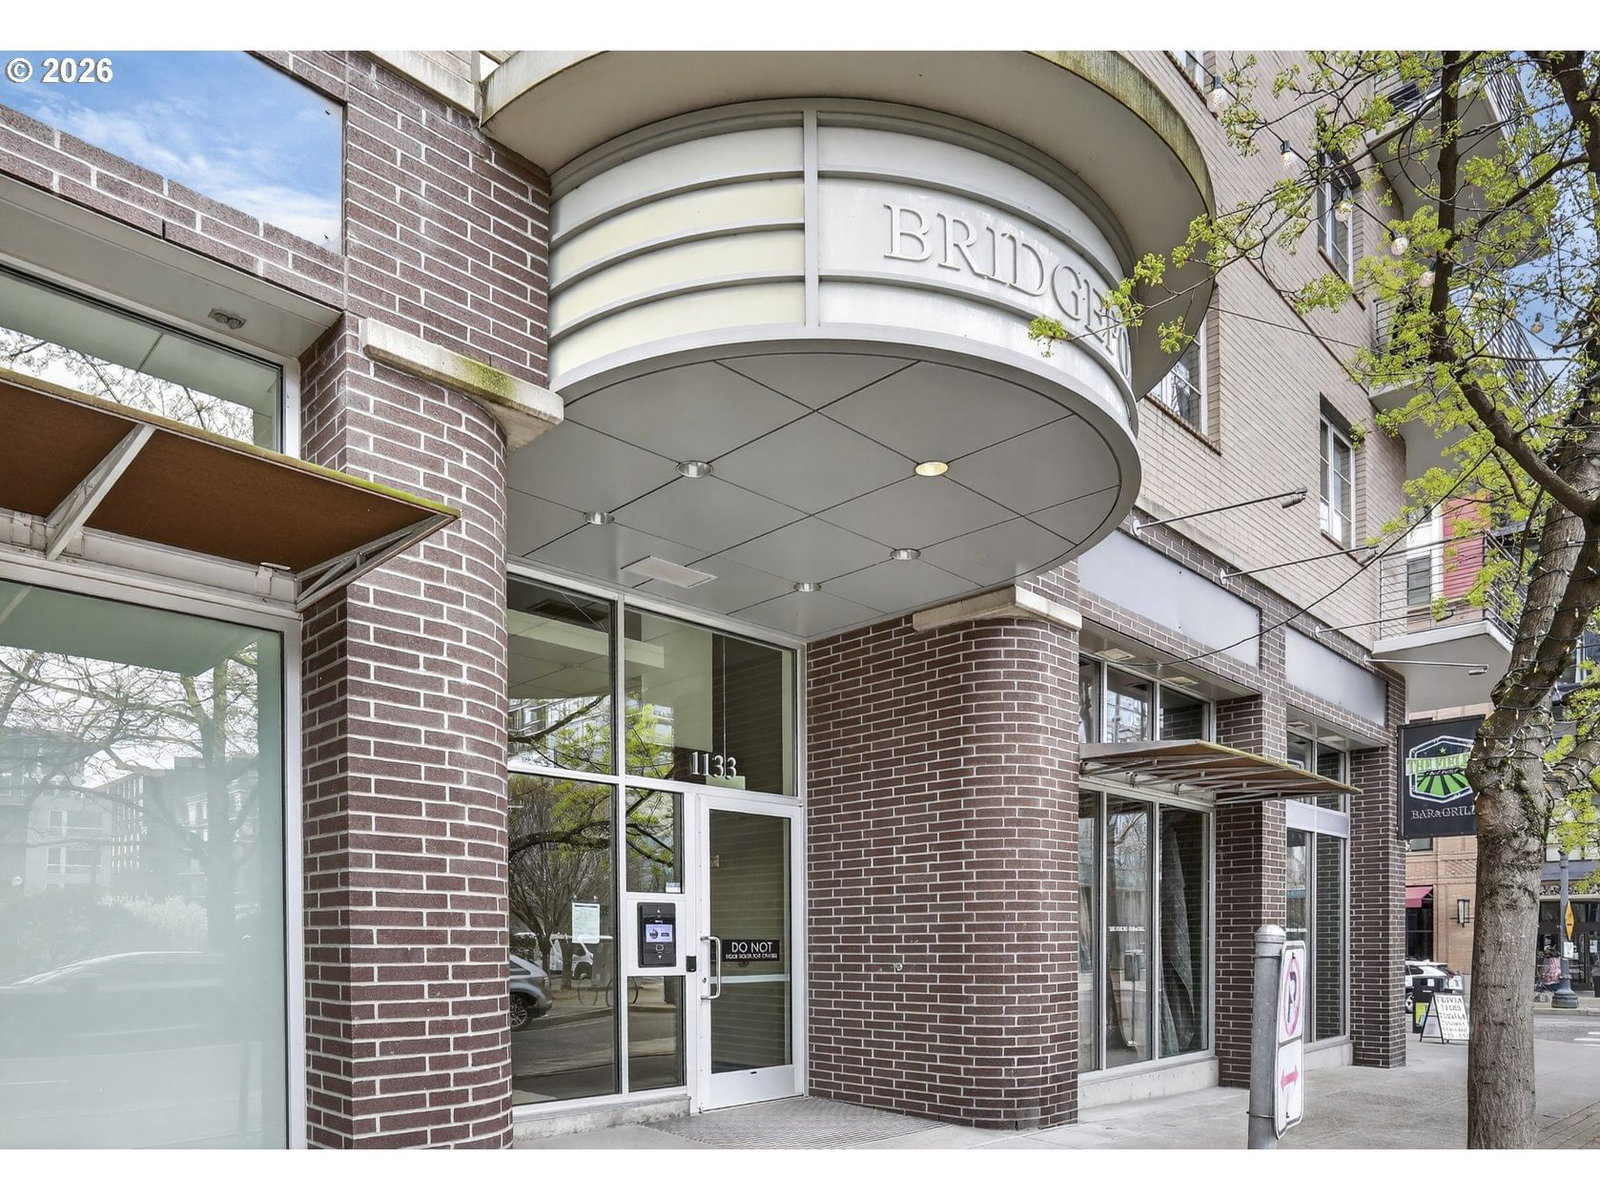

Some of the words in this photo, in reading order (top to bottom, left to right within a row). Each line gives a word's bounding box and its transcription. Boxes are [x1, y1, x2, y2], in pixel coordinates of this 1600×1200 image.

[690, 751, 737, 780] 1133
[731, 942, 748, 953] DO
[750, 942, 773, 953] NOT
